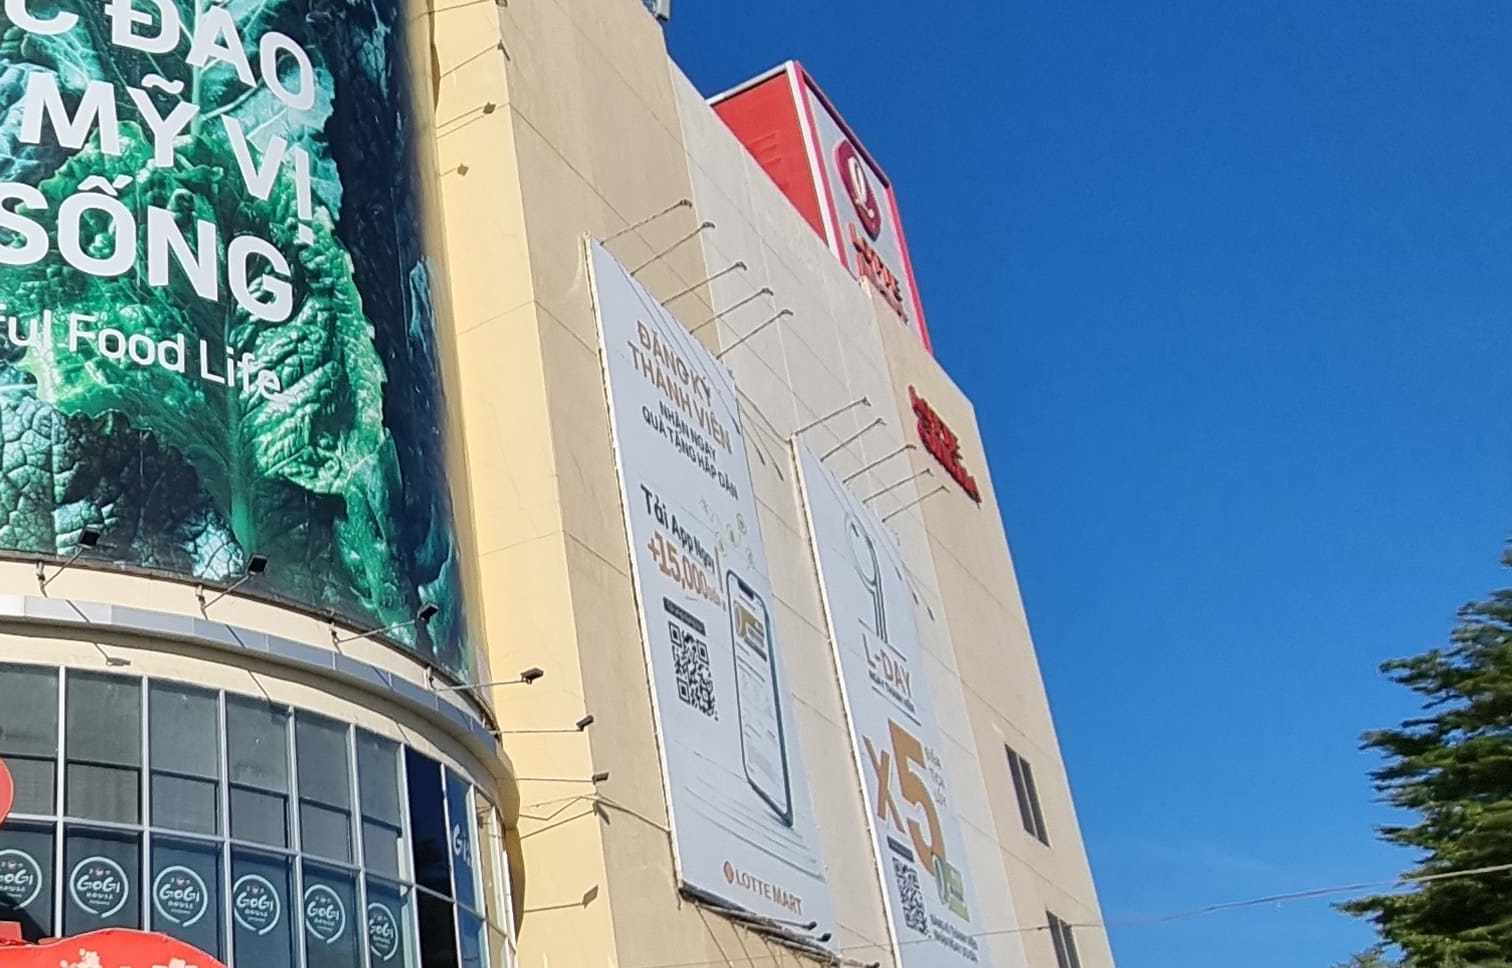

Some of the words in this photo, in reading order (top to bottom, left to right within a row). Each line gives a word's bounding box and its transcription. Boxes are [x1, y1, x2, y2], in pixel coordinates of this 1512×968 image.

[19, 72, 200, 169] MỸ
[222, 114, 316, 246] VỊ
[68, 311, 187, 374] Food
[199, 338, 285, 403] Life
[671, 514, 694, 556] App
